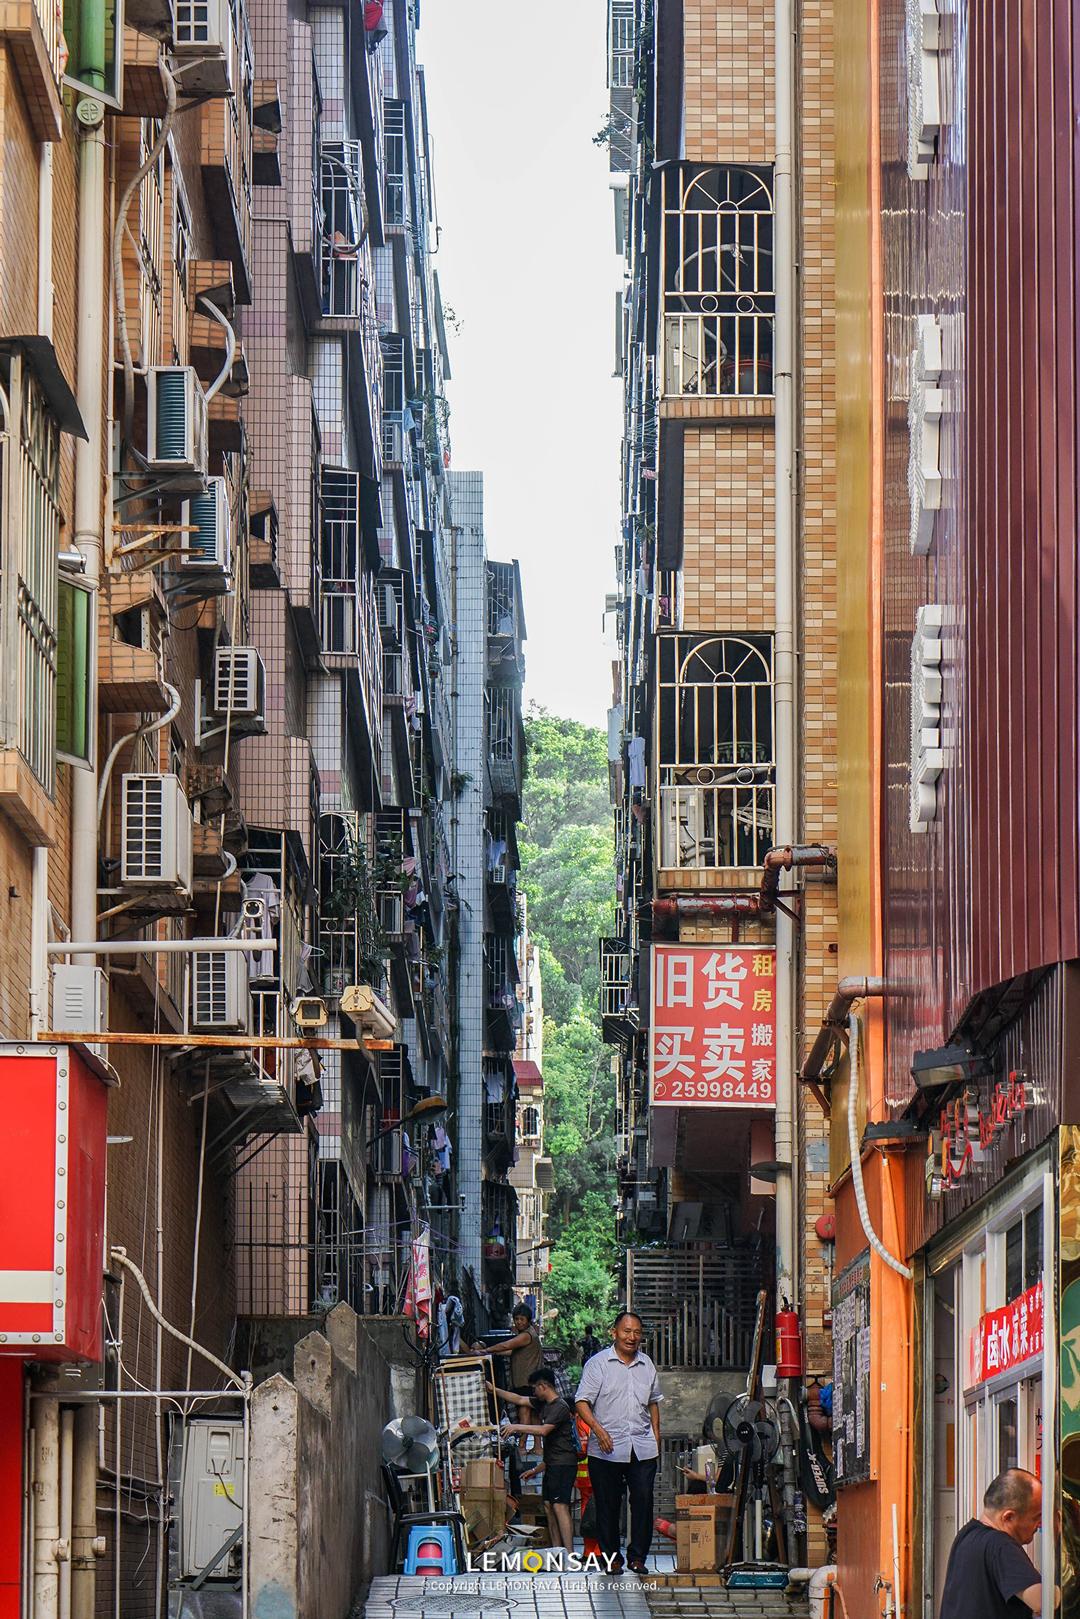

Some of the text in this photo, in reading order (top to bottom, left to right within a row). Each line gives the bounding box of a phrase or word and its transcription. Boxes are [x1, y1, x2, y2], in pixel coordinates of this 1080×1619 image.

[656, 953, 748, 1010] 旧货
[654, 1023, 746, 1081] 买卖
[671, 1081, 772, 1098] 25998449
